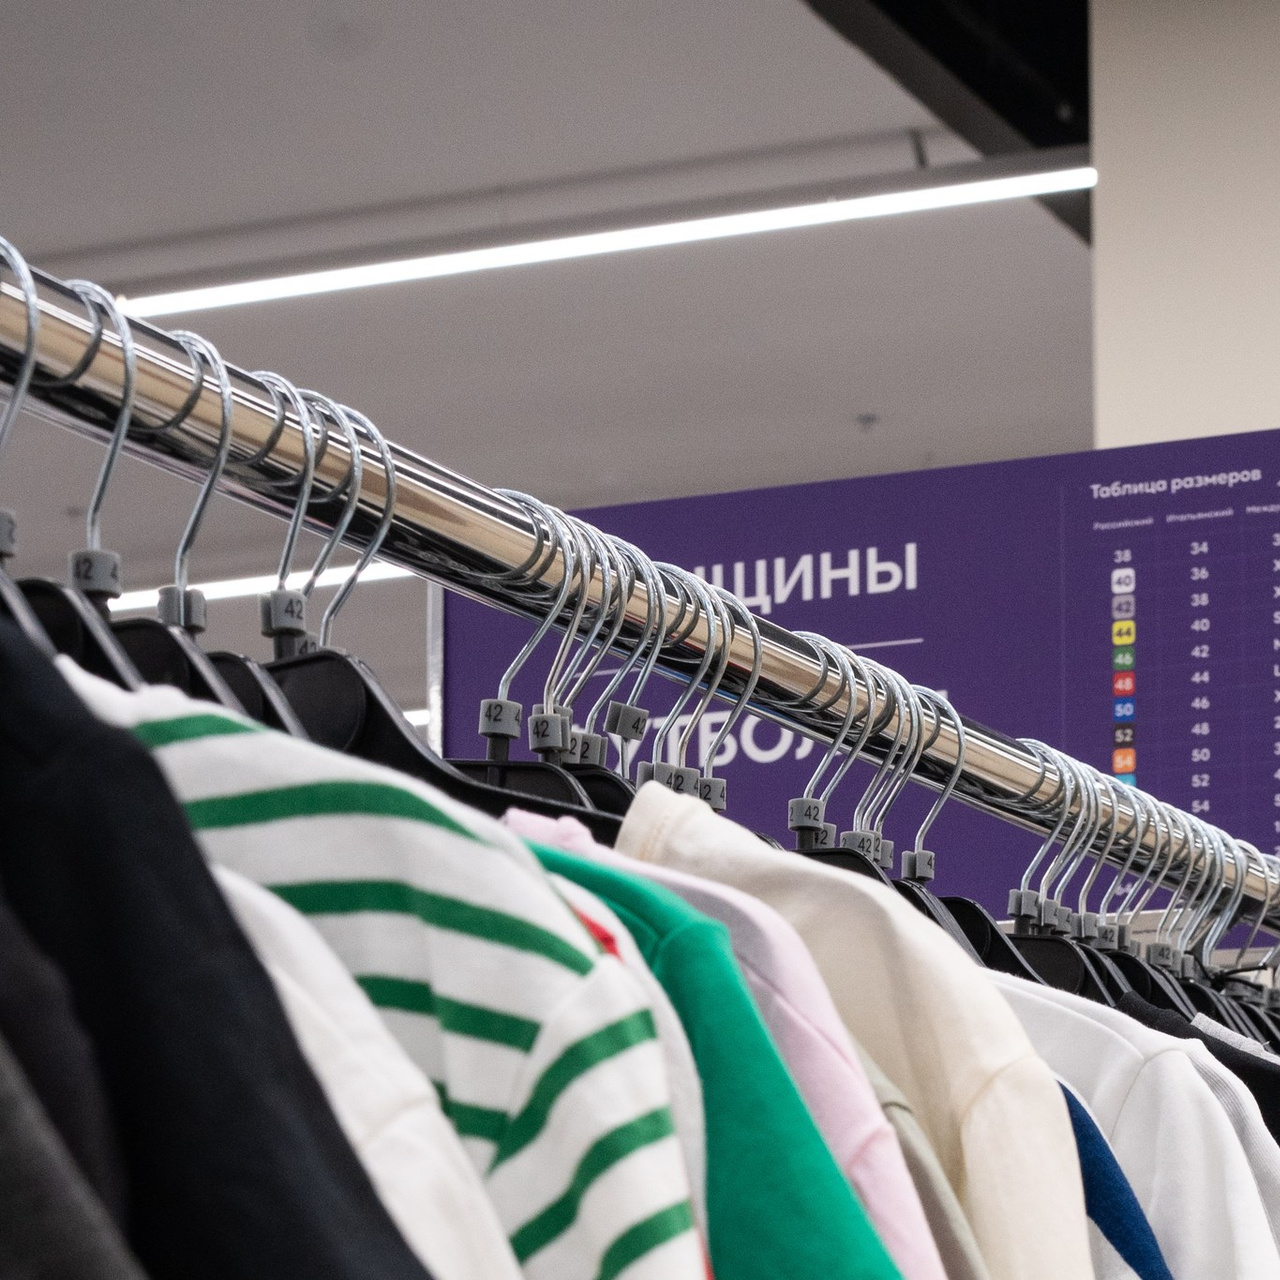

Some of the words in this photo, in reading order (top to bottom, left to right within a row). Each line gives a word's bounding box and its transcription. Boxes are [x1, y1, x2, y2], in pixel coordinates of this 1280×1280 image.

[1090, 477, 1167, 499] Таблица
[1171, 468, 1262, 494] размеров
[1113, 549, 1132, 563] 38
[1190, 541, 1209, 555] 34
[694, 542, 917, 615] ЩИНЫ
[1115, 574, 1132, 587] 40
[1190, 567, 1209, 580] 36
[284, 599, 304, 620] 42
[1115, 601, 1132, 614] 42
[1190, 593, 1209, 607] 38
[1115, 626, 1132, 638] 44
[1190, 618, 1210, 632] 40
[1114, 653, 1134, 666] 46
[1190, 645, 1210, 658] 42
[1114, 678, 1133, 691] 48
[1190, 671, 1210, 684] 44
[485, 704, 503, 722] 42
[1115, 702, 1134, 717] 50
[1191, 696, 1210, 710] 46
[532, 720, 550, 738] 42
[1115, 729, 1133, 742] 52
[1191, 722, 1210, 735] 48
[1191, 748, 1210, 762] 50
[1191, 774, 1210, 787] 52
[804, 805, 819, 822] 42
[1191, 800, 1210, 813] 54
[858, 838, 872, 854] 42
[1101, 929, 1115, 943] 42
[1158, 946, 1170, 960] 42
